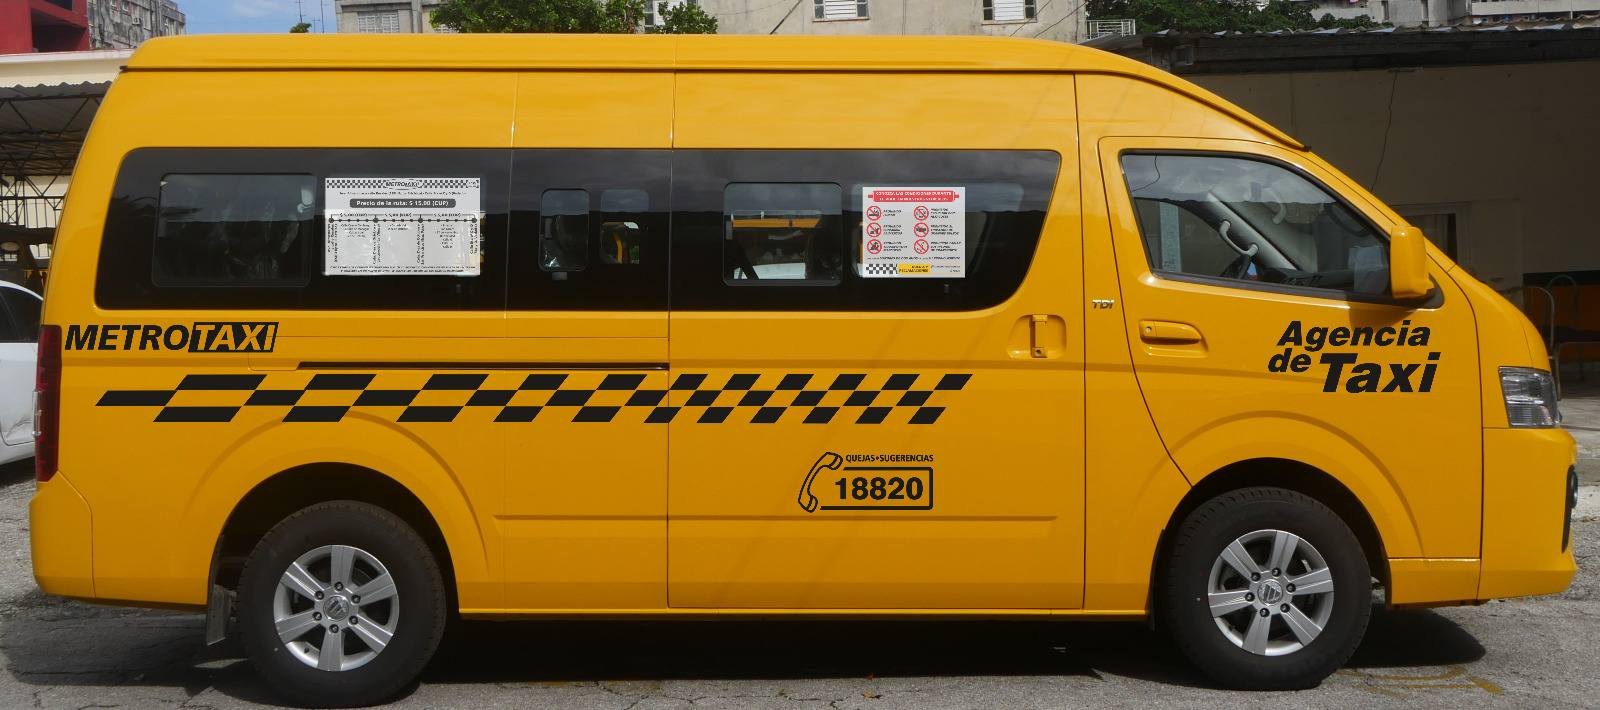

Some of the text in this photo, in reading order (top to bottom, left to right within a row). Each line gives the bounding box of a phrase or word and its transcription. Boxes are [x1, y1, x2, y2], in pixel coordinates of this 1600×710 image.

[1092, 299, 1115, 309] TDI
[1276, 320, 1431, 352] Agencia
[1267, 348, 1442, 393] de Taxi
[834, 477, 924, 500] 18820
